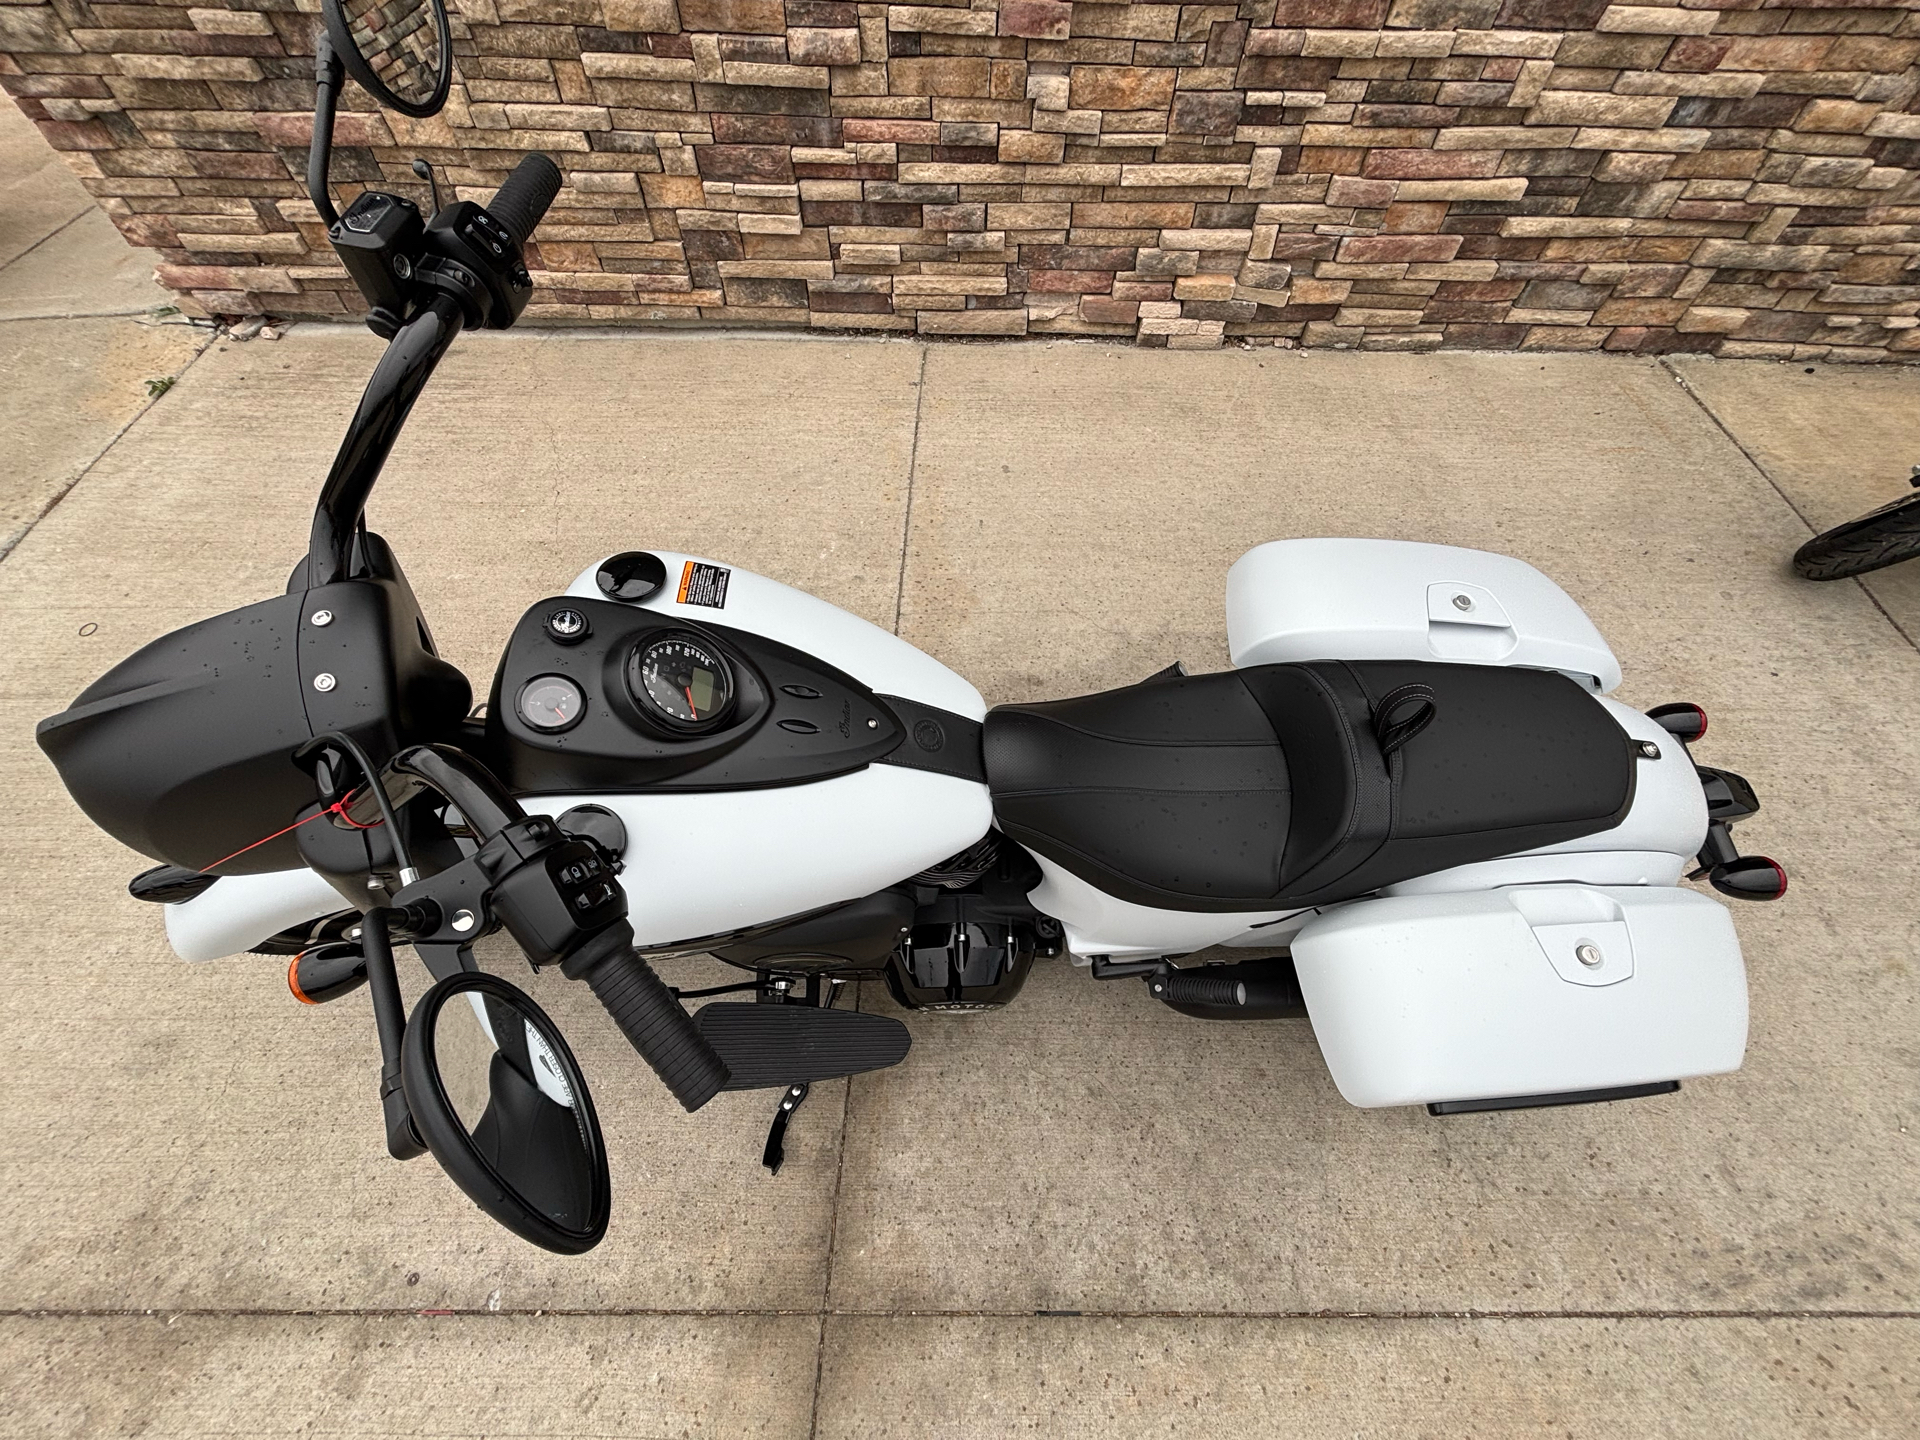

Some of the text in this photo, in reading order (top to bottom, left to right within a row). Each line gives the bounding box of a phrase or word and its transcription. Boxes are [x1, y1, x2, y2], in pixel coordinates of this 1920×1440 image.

[651, 650, 657, 658] 80
[642, 665, 649, 675] 60
[650, 663, 658, 683] Indian
[537, 1039, 550, 1057] THAN
